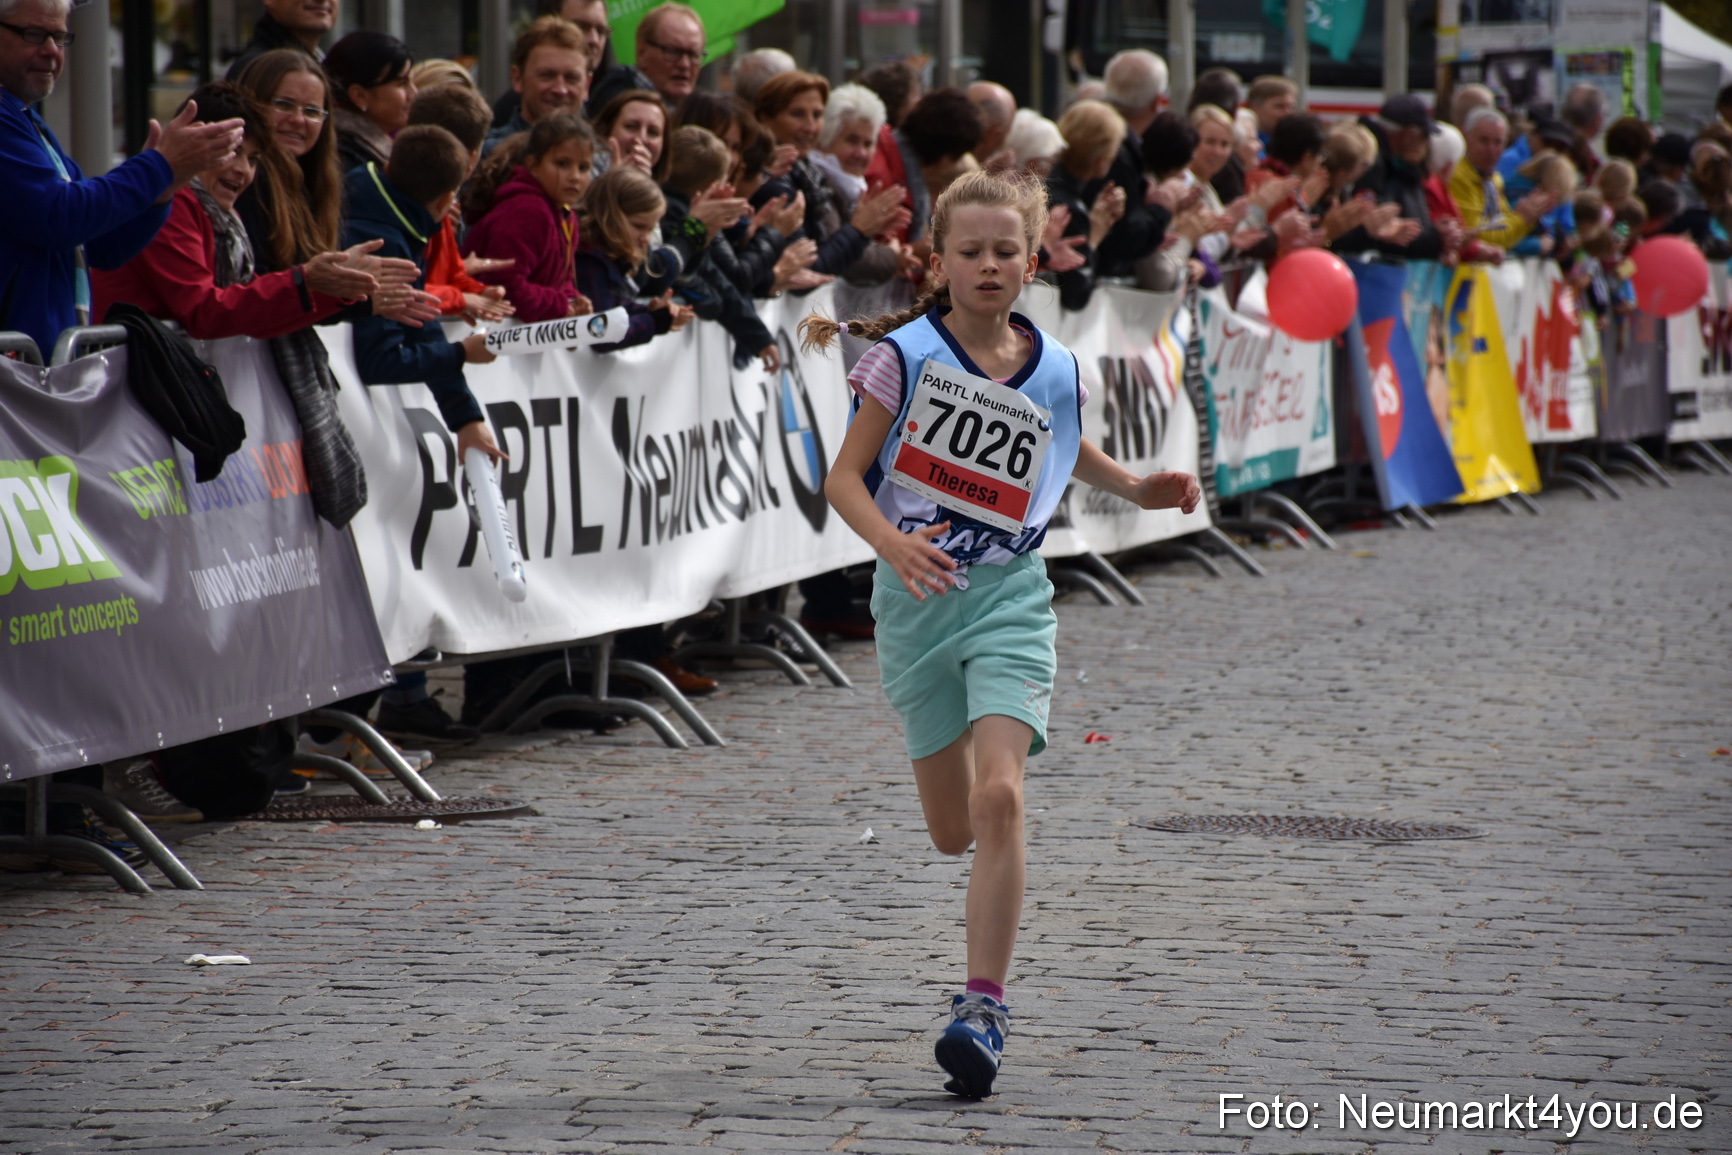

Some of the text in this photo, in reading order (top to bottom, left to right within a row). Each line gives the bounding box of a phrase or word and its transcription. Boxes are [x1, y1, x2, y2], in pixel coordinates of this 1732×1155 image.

[487, 319, 578, 350] BMW Laufs
[922, 373, 1034, 424] PARTL Neumarkt
[612, 332, 781, 550] Neumarkt
[906, 434, 913, 443] 5
[922, 397, 1037, 480] 7026
[108, 459, 188, 520] OFFICE
[252, 439, 311, 499] LOUN
[929, 462, 999, 506] Theresa
[0, 472, 106, 577] CK
[189, 531, 320, 610] www.bockonline.de
[9, 593, 139, 646] smart concepts
